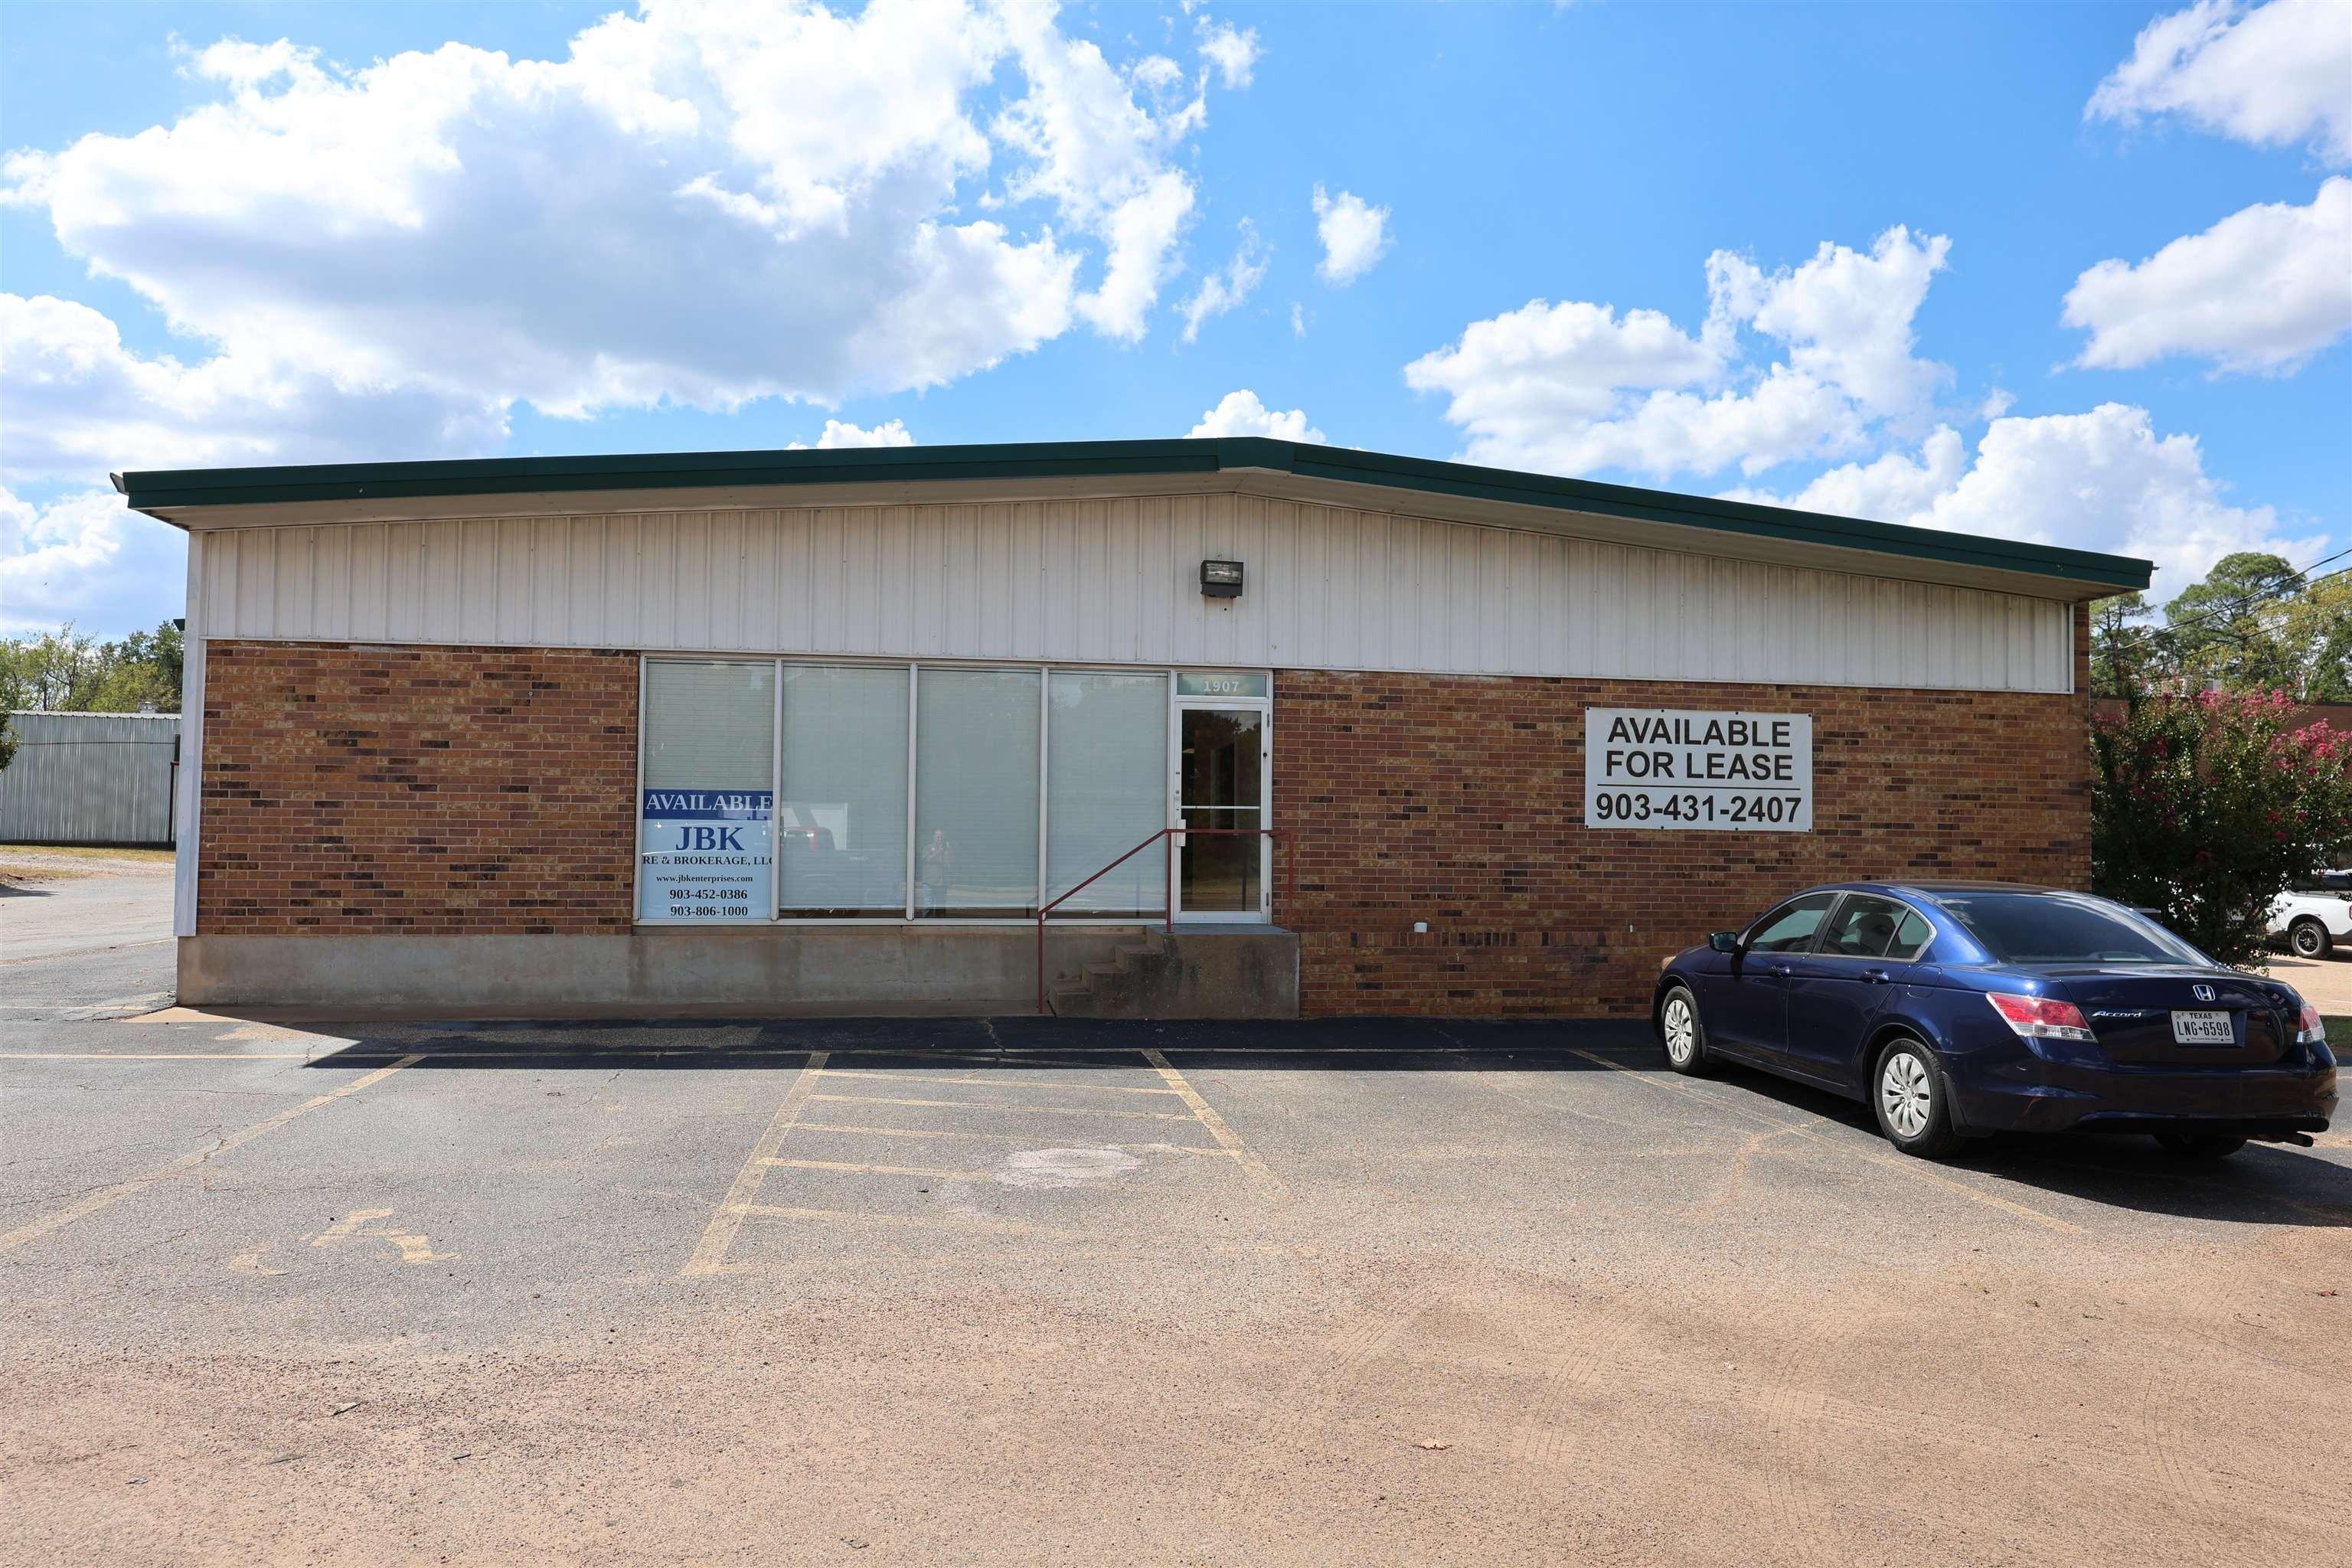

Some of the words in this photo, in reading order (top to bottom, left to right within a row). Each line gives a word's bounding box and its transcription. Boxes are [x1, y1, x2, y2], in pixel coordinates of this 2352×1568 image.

[1204, 681, 1239, 692] 1907
[1607, 717, 1791, 747] AVAILABLE
[1606, 750, 1675, 778] FOR
[1687, 753, 1793, 780] LEASE
[645, 794, 773, 811] AVAILABLE
[1596, 793, 1802, 823] 903-431-2407
[675, 826, 745, 851] JBK
[642, 856, 658, 865] RE
[662, 856, 671, 865] &
[674, 856, 751, 867] BROKERAGE,
[656, 874, 753, 884] www.jbkenterprises.com
[669, 889, 748, 900] 903-452-0386
[670, 906, 749, 916] 903-806-1000
